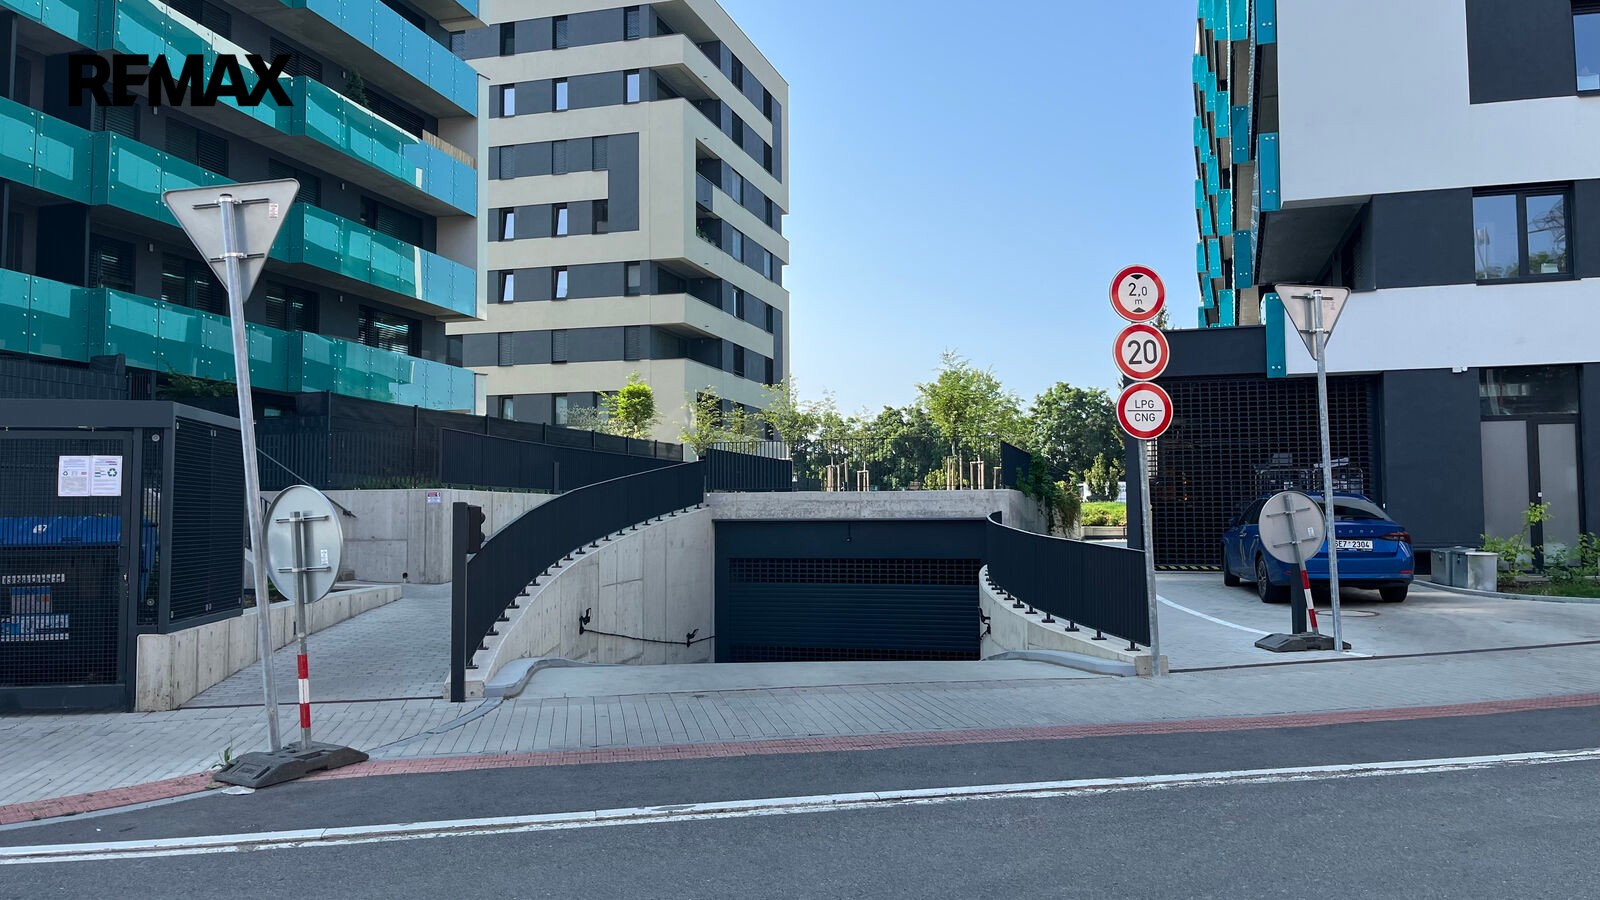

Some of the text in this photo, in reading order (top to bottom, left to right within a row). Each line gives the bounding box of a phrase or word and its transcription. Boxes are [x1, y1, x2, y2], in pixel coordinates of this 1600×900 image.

[1128, 282, 1148, 297] 2,0
[1127, 339, 1158, 365] 20
[1134, 399, 1155, 409] LPG
[1134, 413, 1156, 422] CNG
[1352, 540, 1370, 548] 2304
